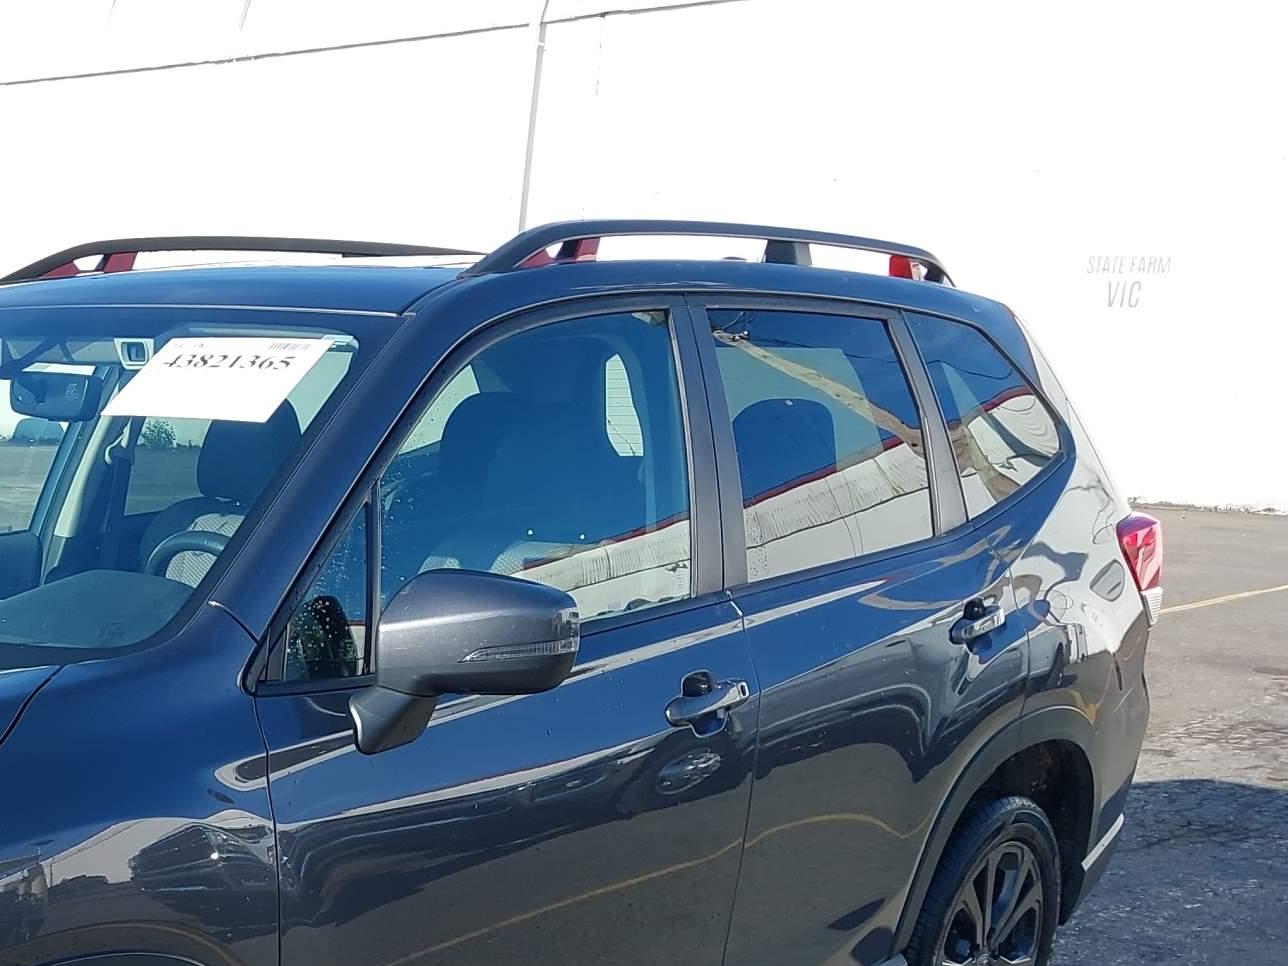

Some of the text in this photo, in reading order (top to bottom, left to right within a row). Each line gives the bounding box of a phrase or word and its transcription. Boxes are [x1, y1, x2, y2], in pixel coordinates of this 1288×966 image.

[1086, 255, 1172, 274] STATE FARM
[1107, 280, 1142, 308] VIC
[163, 353, 297, 371] 43821365
